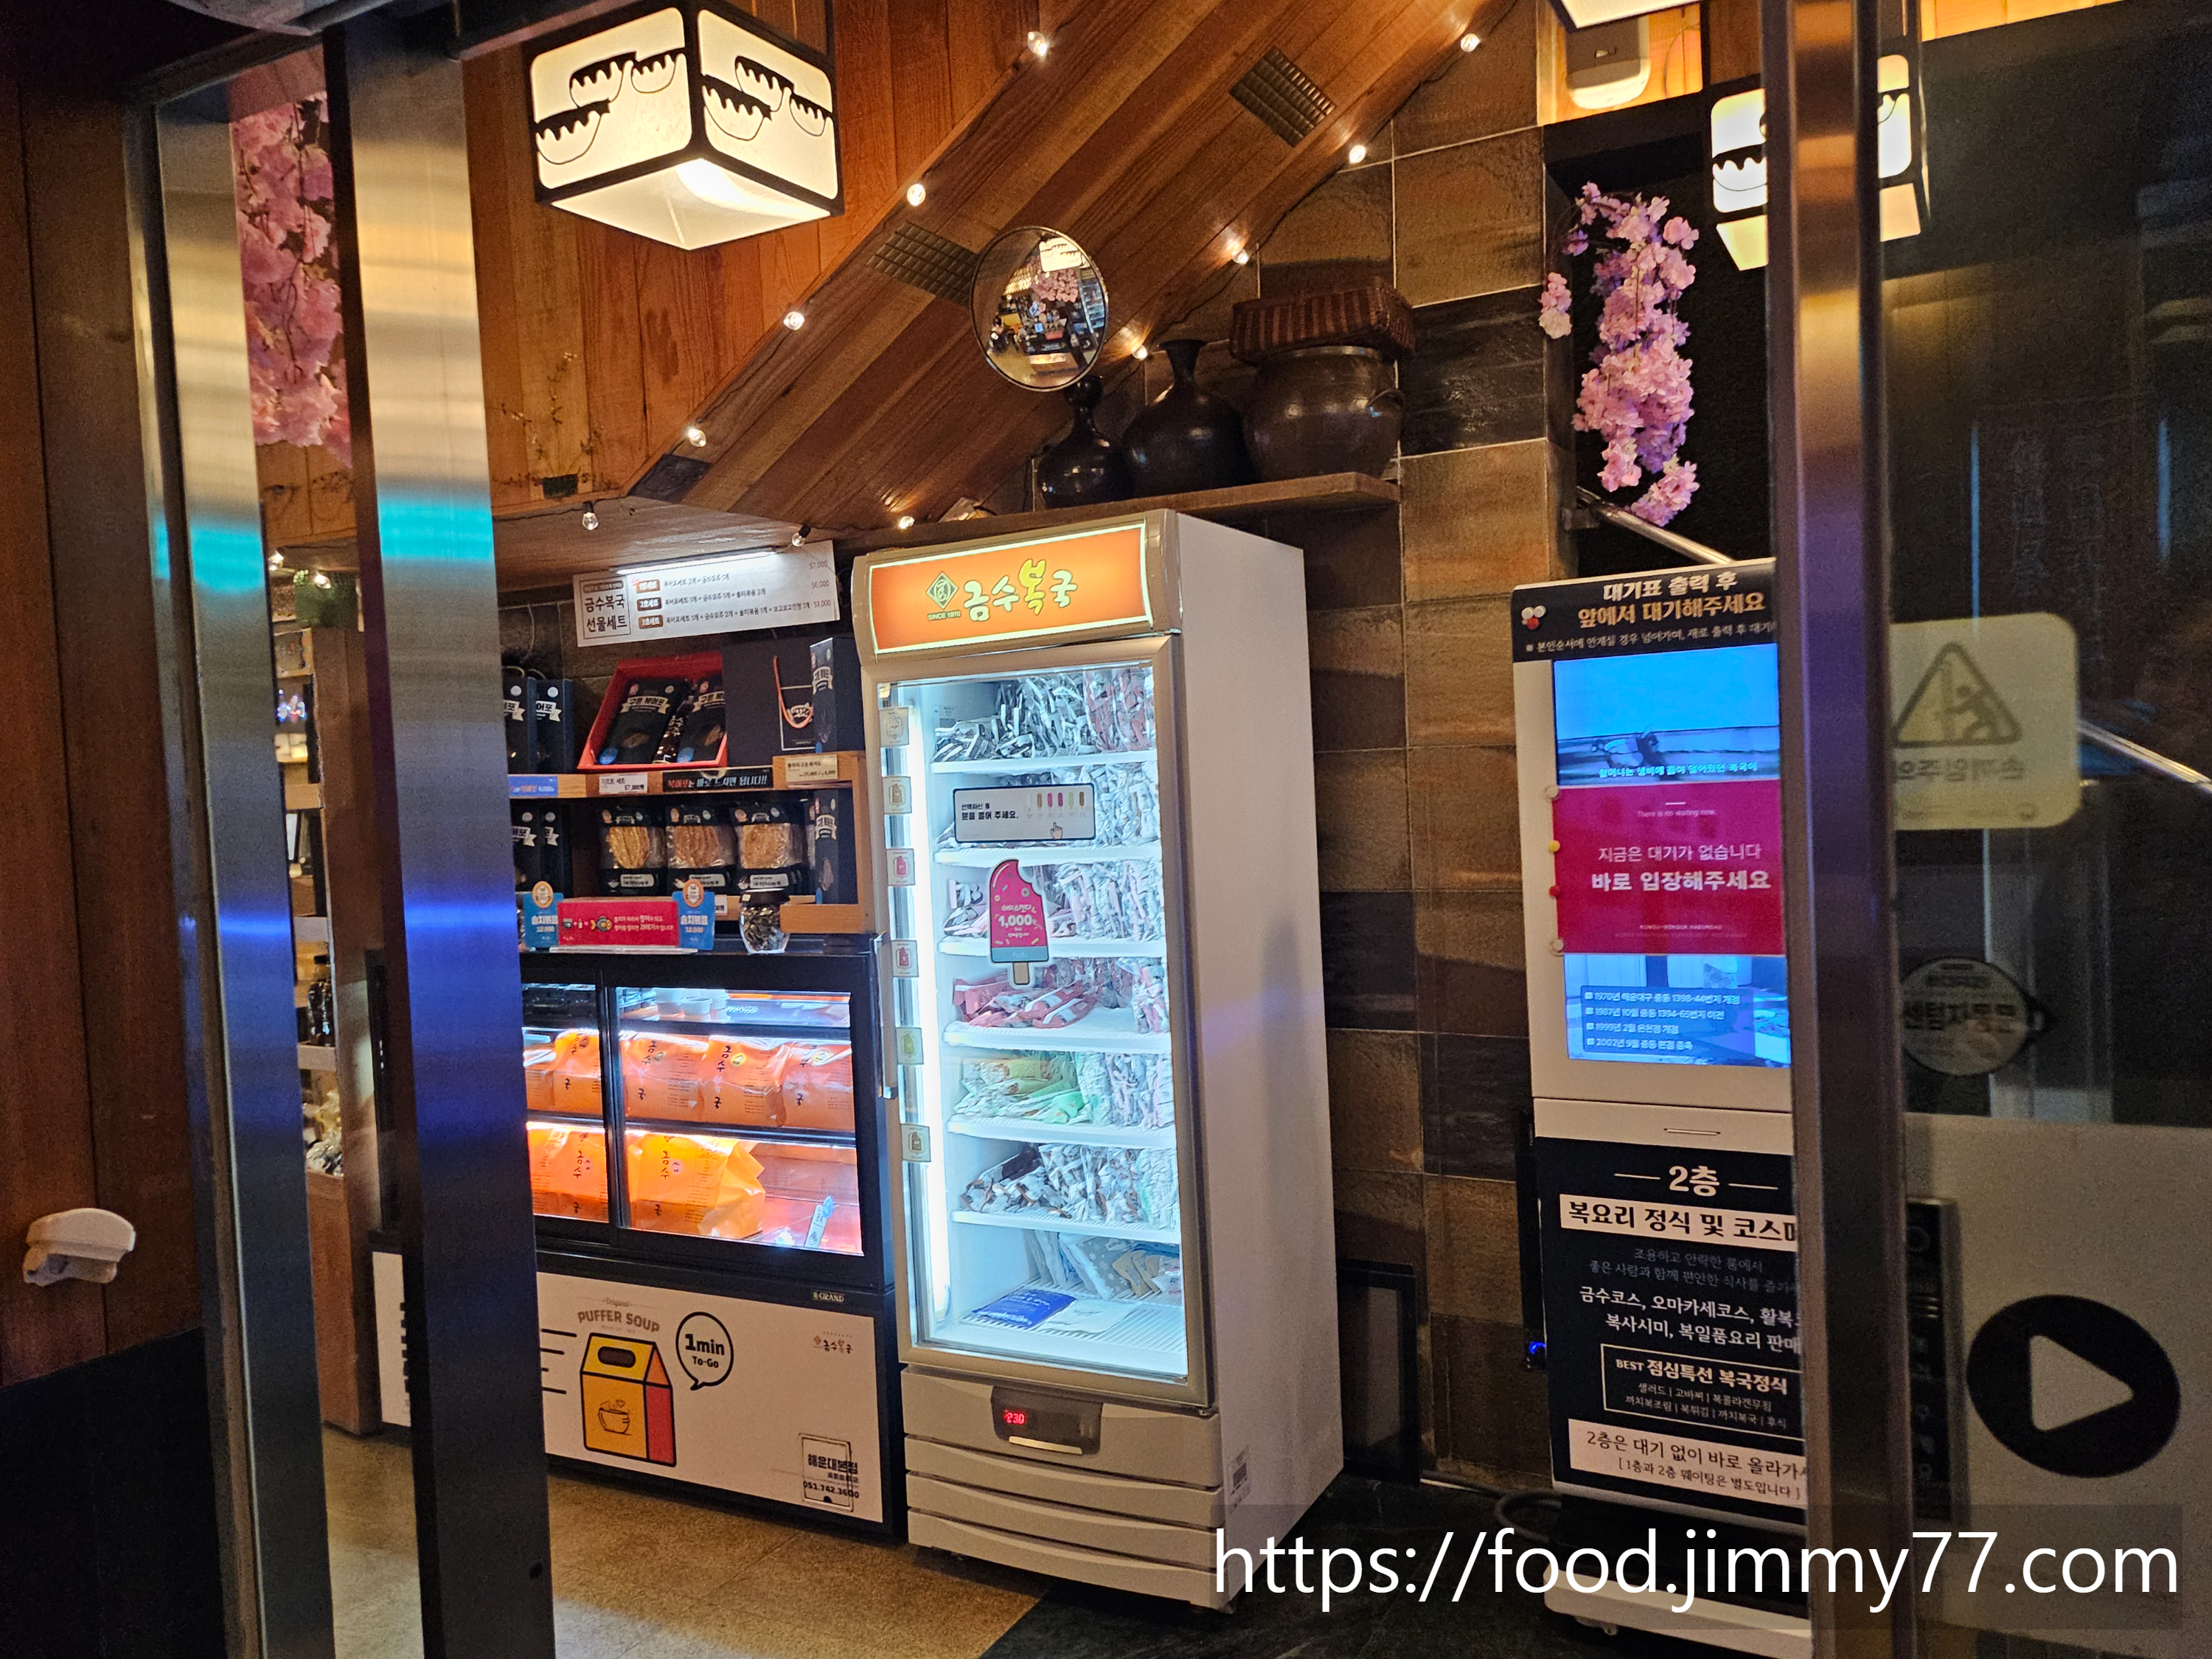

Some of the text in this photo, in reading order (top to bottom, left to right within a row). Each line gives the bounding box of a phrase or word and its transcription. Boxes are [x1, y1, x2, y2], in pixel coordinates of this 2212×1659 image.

[809, 560, 828, 569] 57,000
[811, 580, 830, 589] 56,000
[964, 558, 1078, 622] 금수복국
[1603, 571, 1738, 602] 대기표 출력 후
[585, 594, 625, 612] 금수복국
[813, 599, 831, 608] 59,000
[1578, 592, 1766, 629] 앞에서 대기해주세요
[587, 615, 627, 633] 선물세트
[927, 610, 961, 621] SINCE 1970
[1618, 632, 1640, 646] 경우
[961, 812, 975, 821] 문을
[978, 811, 992, 820] 열어
[995, 810, 1019, 820] 주세요.
[1598, 844, 1762, 863] 지금은 대기가 없습니다
[1591, 870, 1771, 892] 바로 입장해주세요
[1669, 1165, 1720, 1197] 2층
[1568, 1201, 1635, 1228] 복요리
[1644, 1208, 1690, 1234] 정식
[1700, 1213, 1724, 1237] 및
[1634, 1248, 1681, 1264] 조용하고
[1685, 1253, 1722, 1269] 안락한
[1589, 1260, 1613, 1273] 좋은
[1615, 1262, 1650, 1278] 사람과
[1654, 1267, 1679, 1282] 함께
[1683, 1270, 1719, 1287] 편안한
[1724, 1275, 1759, 1291] 식사를
[606, 1297, 629, 1308] Original
[818, 1293, 844, 1303] GRAND
[1579, 1286, 1646, 1311] 금수코스,
[1651, 1295, 1755, 1324] 오마카세코스,
[577, 1310, 622, 1324] PUFFER
[626, 1312, 661, 1333] SOUP
[1605, 1313, 1674, 1339] 복사시미,
[1678, 1322, 1761, 1349] 복일품요리
[685, 1333, 725, 1356] 1min
[824, 1339, 853, 1354] 금수복국
[692, 1356, 719, 1368] To-Go
[1615, 1359, 1788, 1395] BEST 점심특선 복국정식
[1638, 1382, 1667, 1396] 샐러드
[1718, 1409, 1757, 1425] 까치복국
[1587, 1431, 1628, 1452] 2층은
[1633, 1438, 1664, 1458] 대기
[1671, 1444, 1703, 1465] 없이
[1708, 1452, 1742, 1470] 바로
[807, 1454, 858, 1475] 해운대본점
[1658, 1465, 1676, 1478] 2층
[1680, 1470, 1727, 1487] 웨이팅은
[1731, 1477, 1791, 1498] 별도입니다
